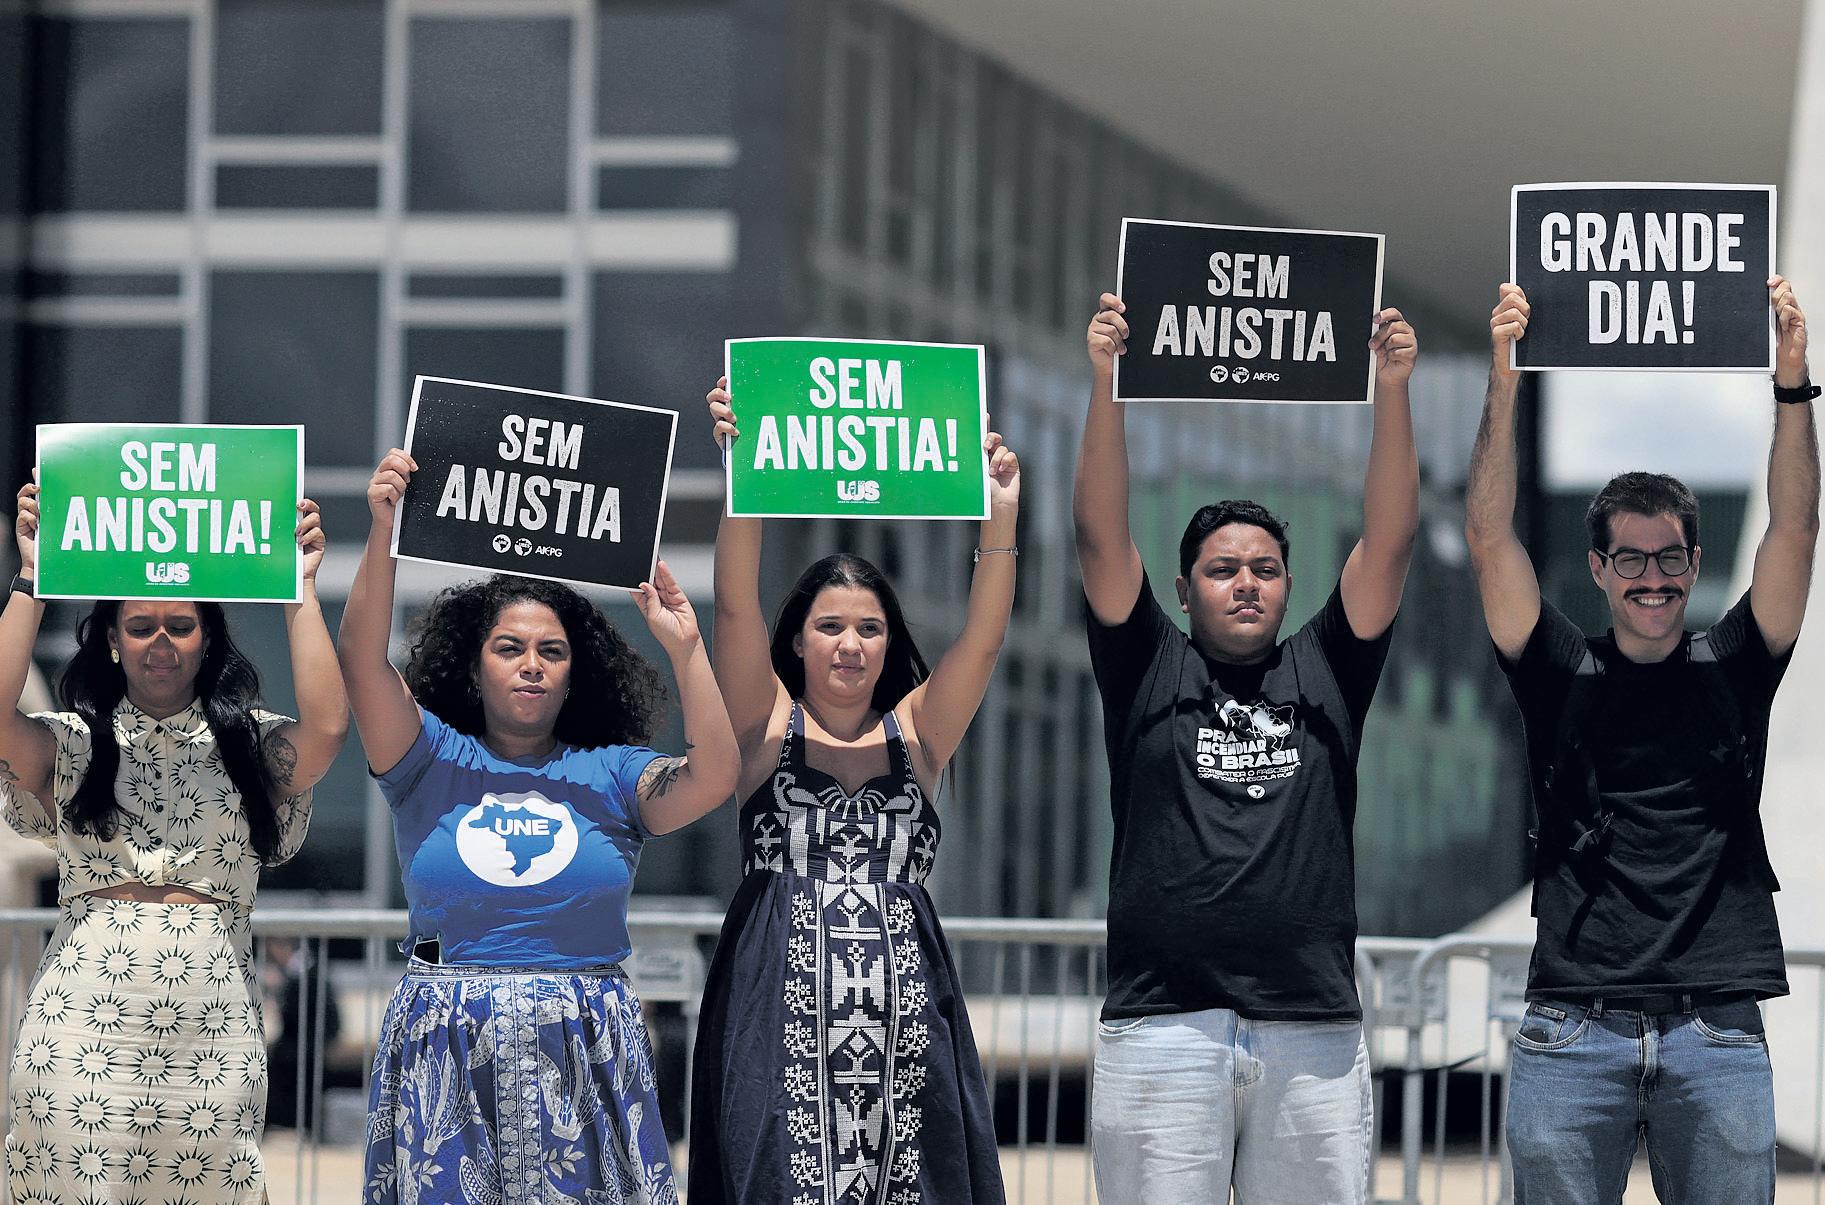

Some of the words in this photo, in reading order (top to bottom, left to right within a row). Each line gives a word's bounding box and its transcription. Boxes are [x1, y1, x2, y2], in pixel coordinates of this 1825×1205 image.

[1540, 211, 1745, 273] GRANDE
[1207, 251, 1290, 299] SEM
[1151, 304, 1337, 363] ANISTIA
[1588, 280, 1695, 345] DIA!
[809, 356, 903, 410] SEM
[119, 441, 217, 493] SEM
[498, 414, 584, 470] SEM
[753, 414, 959, 474] ANISTIA!
[60, 496, 272, 557] ANISTIA!
[435, 463, 621, 543] ANISTIA
[1197, 740, 1266, 755] INCENDIAR
[1197, 754, 1215, 767] O
[1198, 728, 1238, 743] PRA
[1198, 767, 1246, 777] COMBATER
[495, 818, 550, 835] UNE
